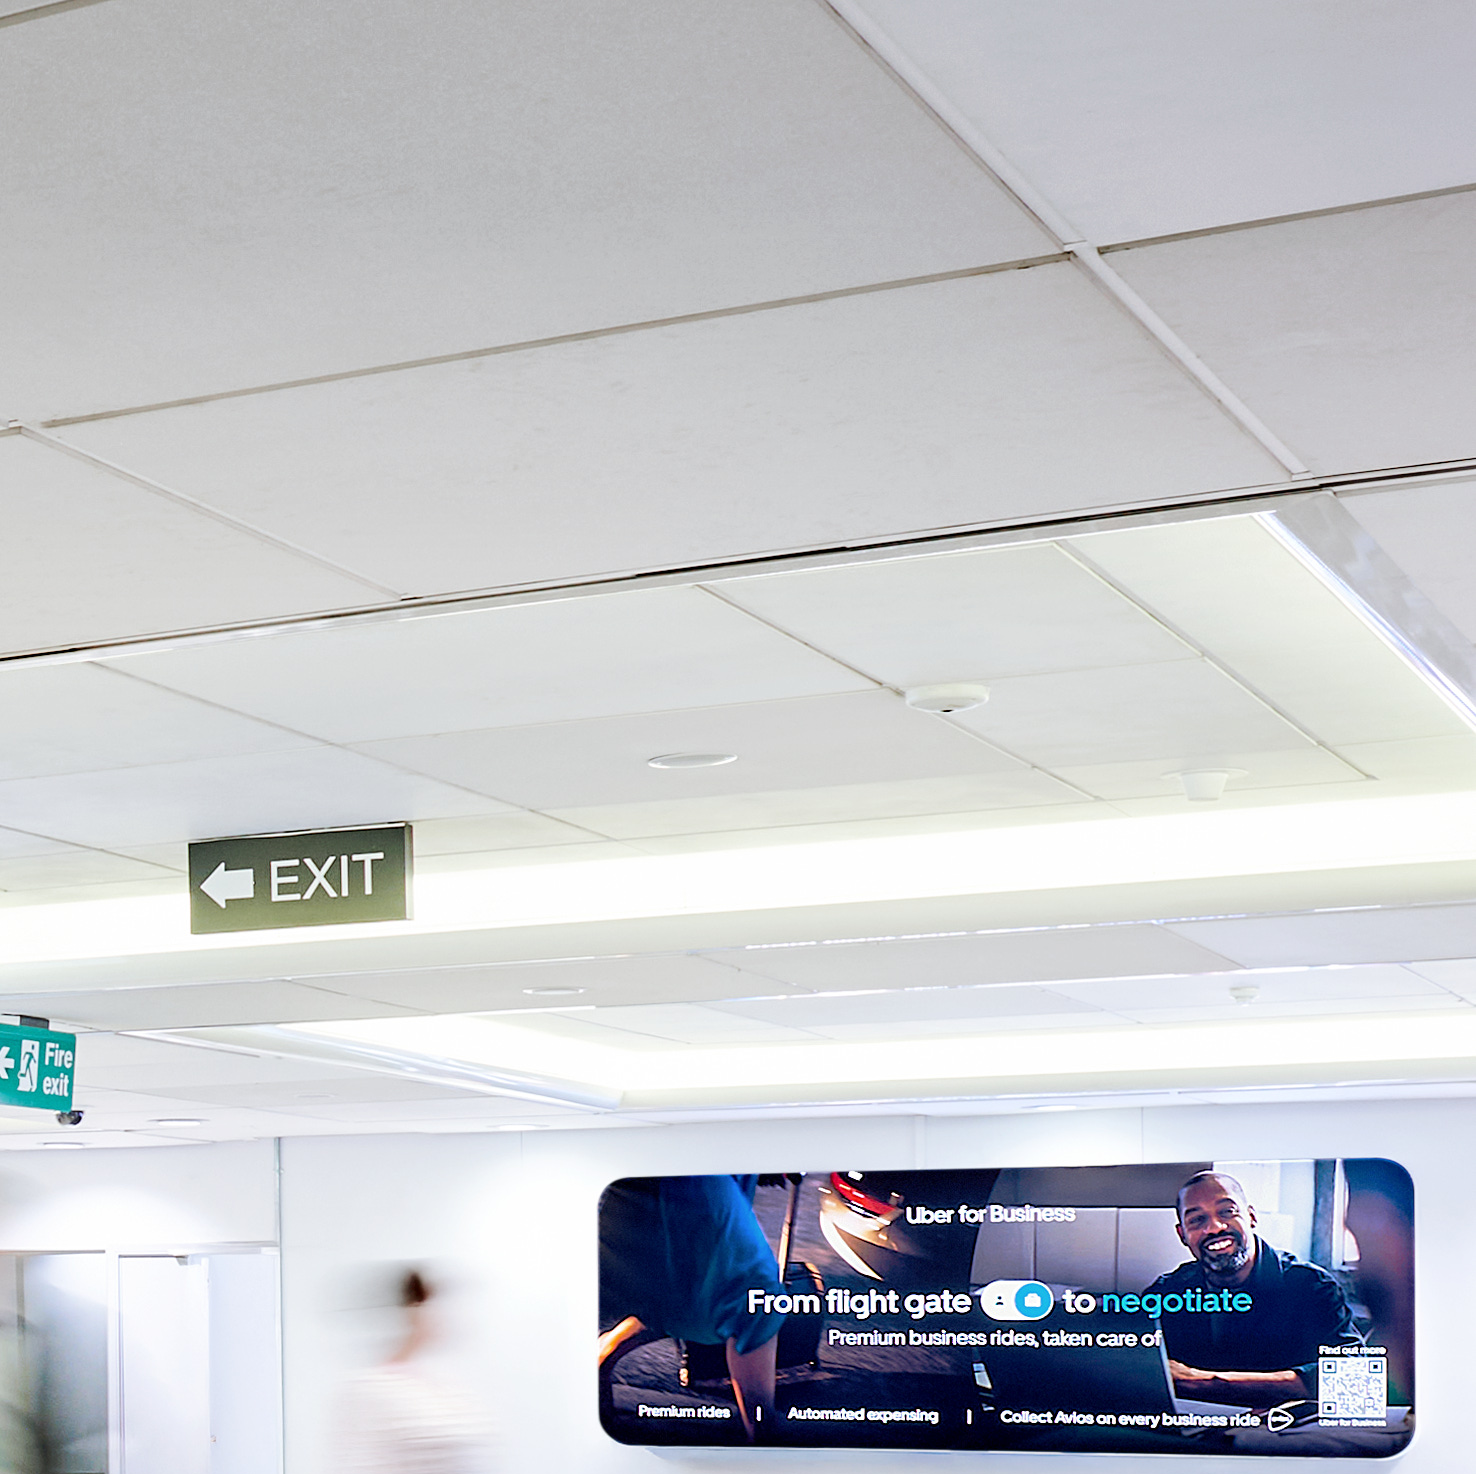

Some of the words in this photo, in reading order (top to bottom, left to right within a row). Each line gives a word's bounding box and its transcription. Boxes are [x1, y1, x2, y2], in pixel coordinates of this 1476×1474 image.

[270, 851, 385, 902] EXIT
[44, 1042, 73, 1069] Fire
[42, 1072, 69, 1097] exit
[906, 1206, 954, 1225] Uber
[959, 1205, 986, 1223] for
[990, 1205, 1076, 1223] Business
[748, 1289, 820, 1314] From
[825, 1289, 900, 1320] flight
[904, 1292, 972, 1320] gate
[1062, 1289, 1097, 1314] to
[1102, 1288, 1253, 1319] negotiate
[829, 1329, 906, 1346] Premium
[909, 1329, 987, 1346] business
[990, 1329, 1039, 1347] rides,
[1042, 1330, 1092, 1346] taken
[1096, 1333, 1139, 1346] care
[1141, 1329, 1162, 1346] of
[1318, 1345, 1340, 1354] Find
[1341, 1346, 1358, 1354] out
[639, 1405, 695, 1418] Premium
[697, 1405, 730, 1419] rides
[788, 1406, 865, 1421] Automated
[867, 1407, 939, 1425] expensing
[1000, 1409, 1052, 1425] Collect
[1055, 1410, 1094, 1426] Avios
[1096, 1414, 1115, 1426] on
[1117, 1414, 1159, 1430] every
[1162, 1411, 1227, 1428] business
[1230, 1412, 1261, 1428] ride
